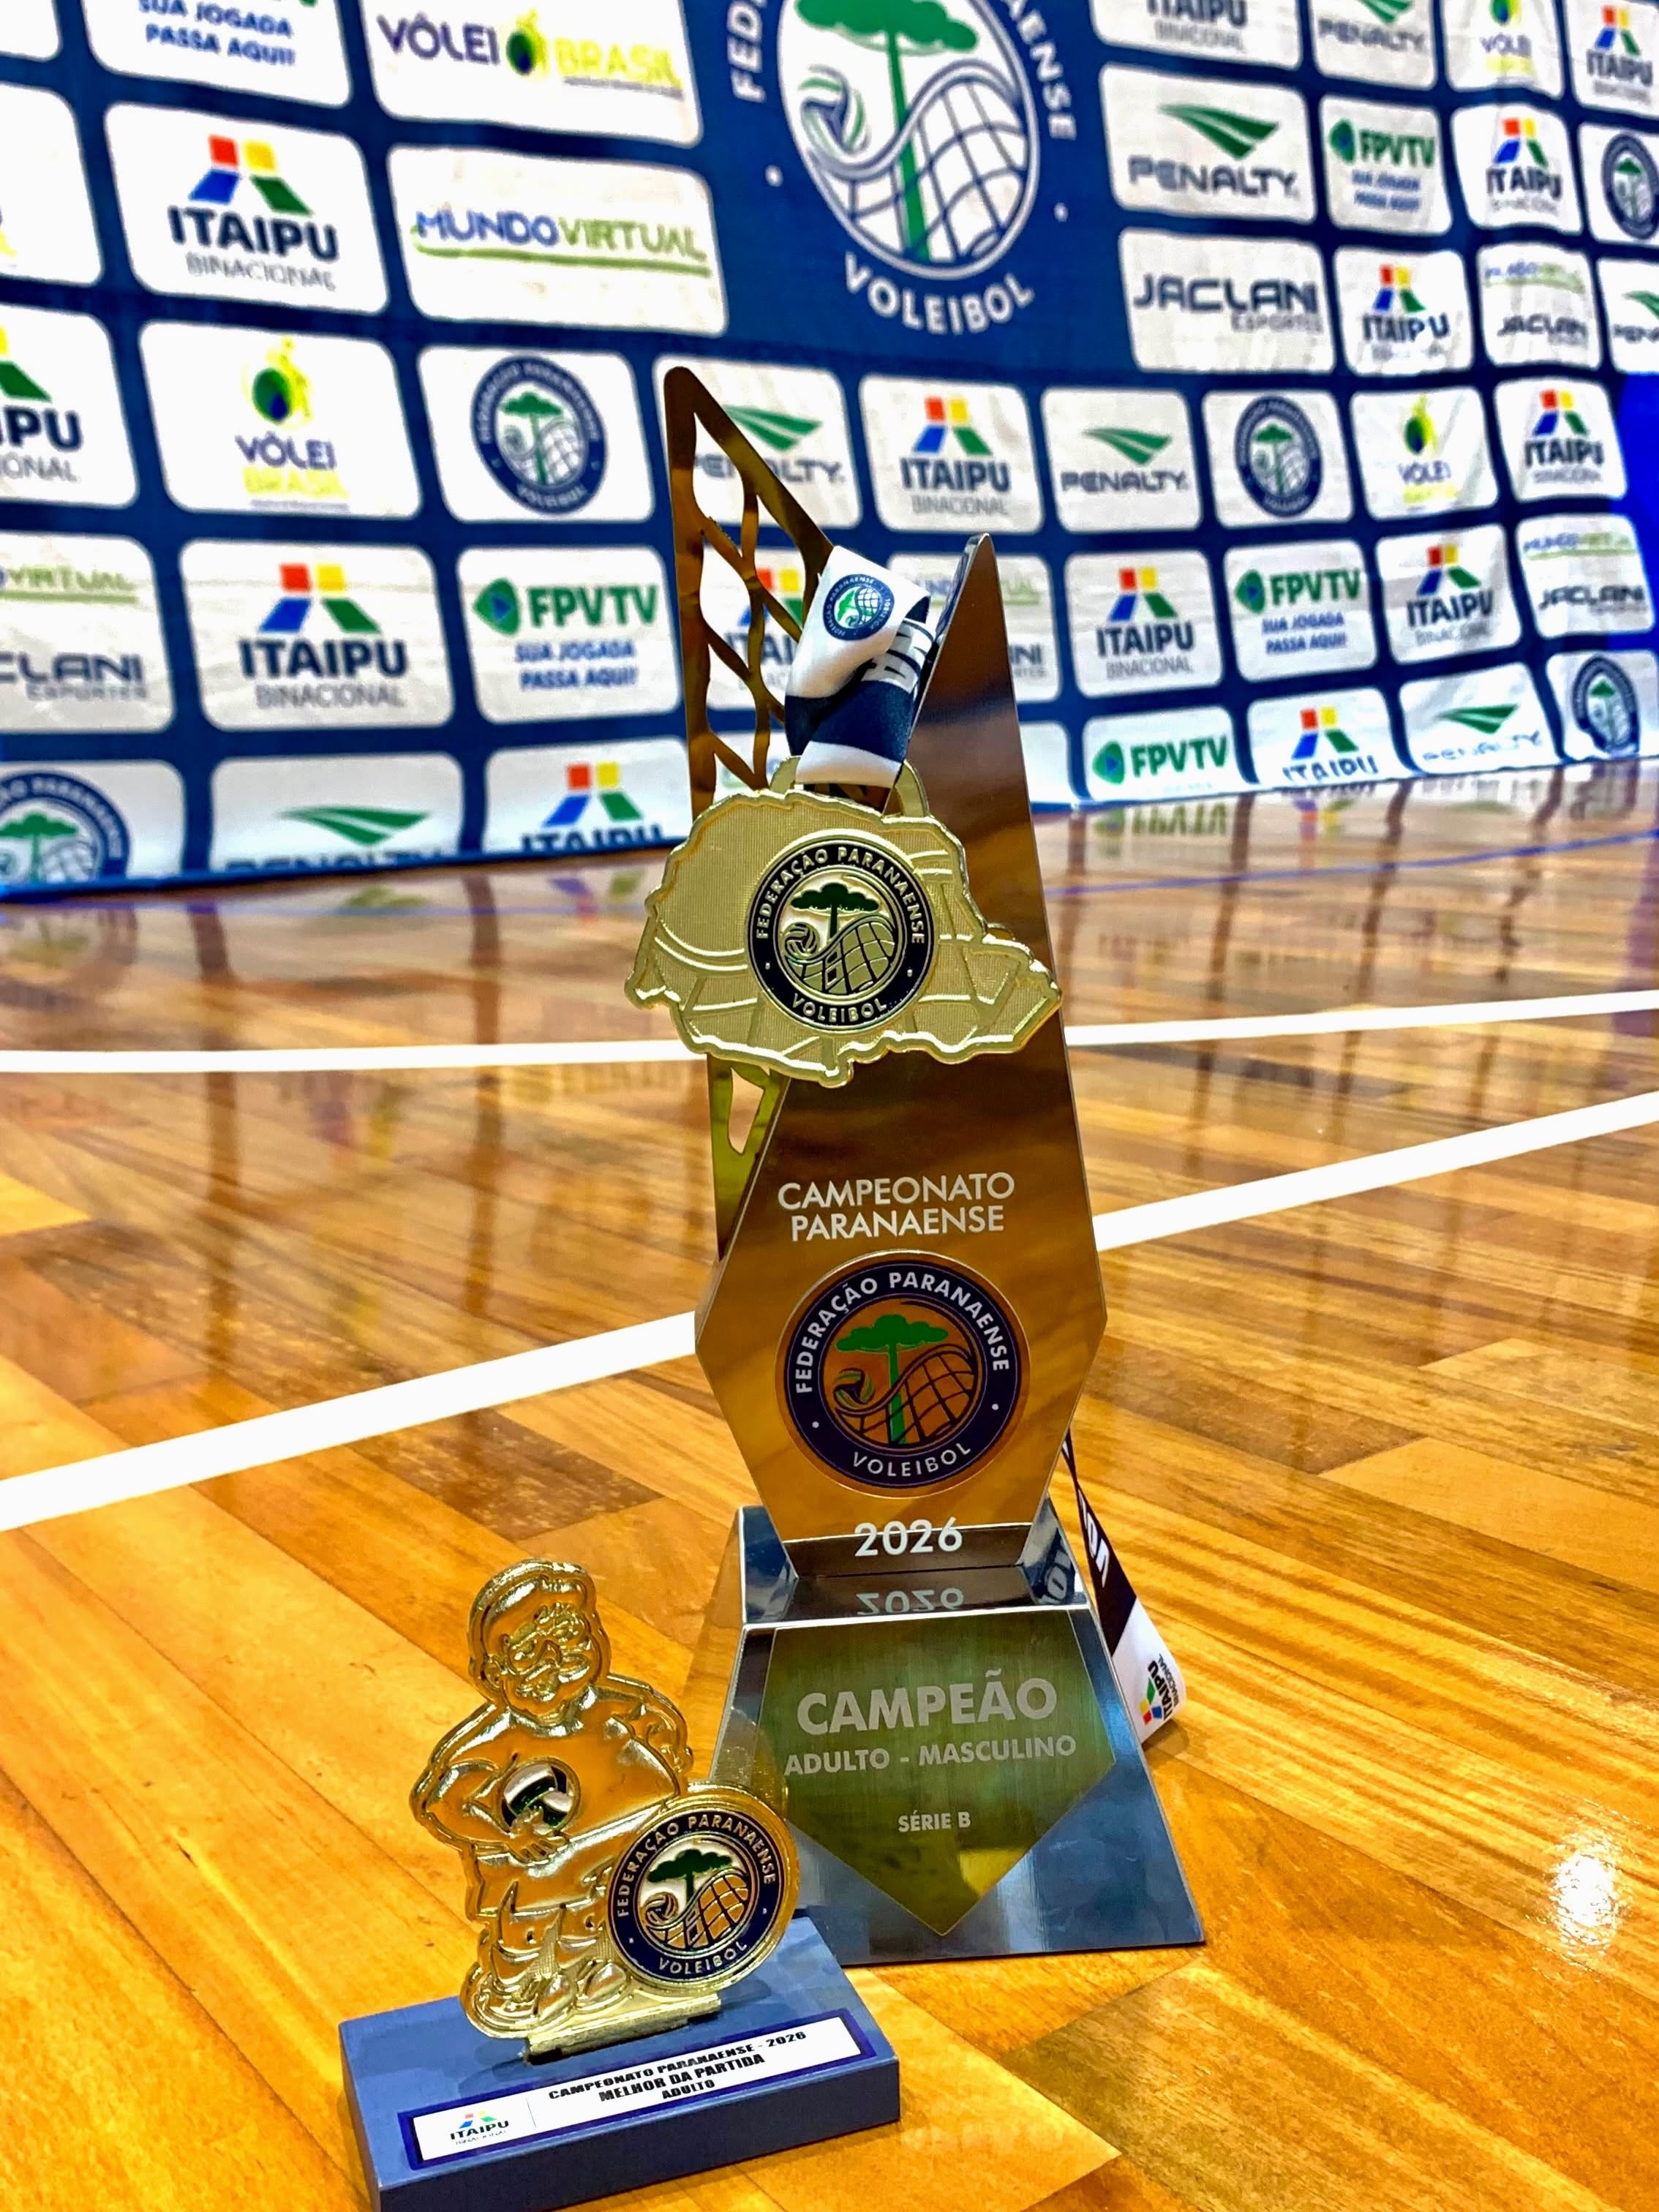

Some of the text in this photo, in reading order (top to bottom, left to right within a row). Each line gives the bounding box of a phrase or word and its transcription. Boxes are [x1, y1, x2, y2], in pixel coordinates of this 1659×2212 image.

[146, 23, 219, 52] PASSA
[195, 2, 293, 37] JOGADA
[376, 12, 683, 89] VÔLEI BRASIL
[1358, 127, 1435, 169] FPVTV
[1127, 154, 1298, 198] PENALTY
[168, 206, 340, 263] ITAIPU
[185, 252, 336, 291] BINACIONAL
[844, 251, 1036, 335] VOLEIBOL
[236, 432, 338, 470] VÔLEI
[900, 456, 1012, 493] ITAIPU
[1061, 470, 1189, 494] PENALTY
[1270, 568, 1361, 606] FPVTV
[527, 586, 657, 628] FPVTV
[1407, 590, 1494, 628] ITAIPU
[238, 639, 407, 680] ITAIPU
[1096, 622, 1195, 658] ITAIPU
[255, 684, 407, 710] BINACIONAL
[1130, 734, 1227, 778] FPVTV
[838, 846, 925, 944] PARANAENSE
[792, 992, 887, 1023] VOLEIBOL
[778, 1172, 1015, 1211] CAMPEONATO
[791, 1205, 1004, 1242] PARANAENSE
[794, 1271, 1010, 1394] FEDERAÇÃO PARANAENSE
[853, 1442, 971, 1477] VOLEIBOL
[854, 1516, 963, 1557] 2026
[797, 1669, 1058, 1736] CAMPEÃO
[783, 1748, 890, 1776] ADULTO
[919, 1734, 1077, 1767] MASCULINO
[898, 1810, 972, 1833] SÉRIE B
[688, 1813, 776, 1885] PARANAENSE
[658, 1941, 748, 1975] VOLEIBOL
[548, 2068, 655, 2101] CAMPEONATO
[657, 2043, 756, 2074] PARANAENSE
[765, 2031, 808, 2048] 2026
[598, 2053, 766, 2103] MELHOR DA PARTIDA
[661, 2079, 716, 2100] ADULTO
[450, 2120, 510, 2140] ITAIPU
